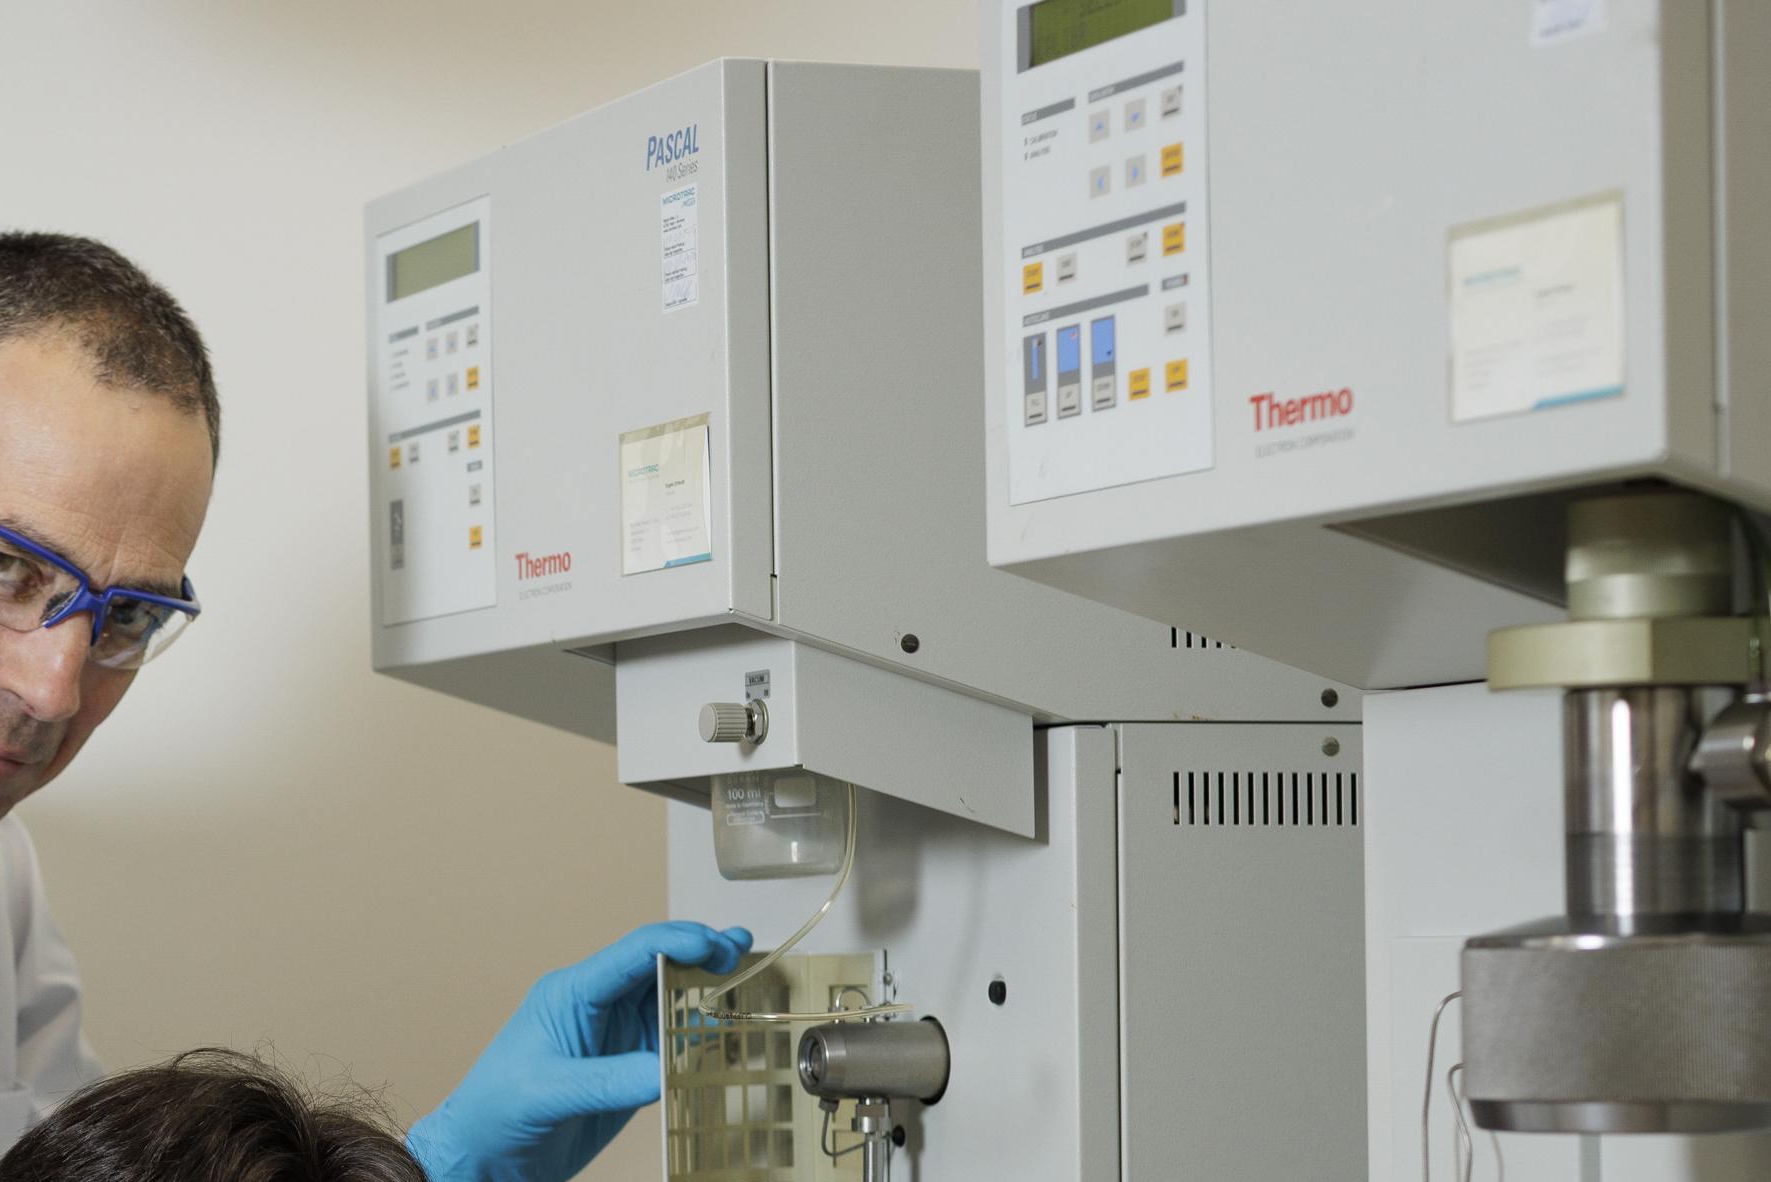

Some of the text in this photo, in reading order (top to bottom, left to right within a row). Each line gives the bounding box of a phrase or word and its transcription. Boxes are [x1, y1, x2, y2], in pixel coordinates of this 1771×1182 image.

[646, 124, 699, 171] PASCAL
[1249, 386, 1353, 432] Thermo
[515, 552, 571, 580] Thermo
[727, 785, 761, 800] 100 ml
